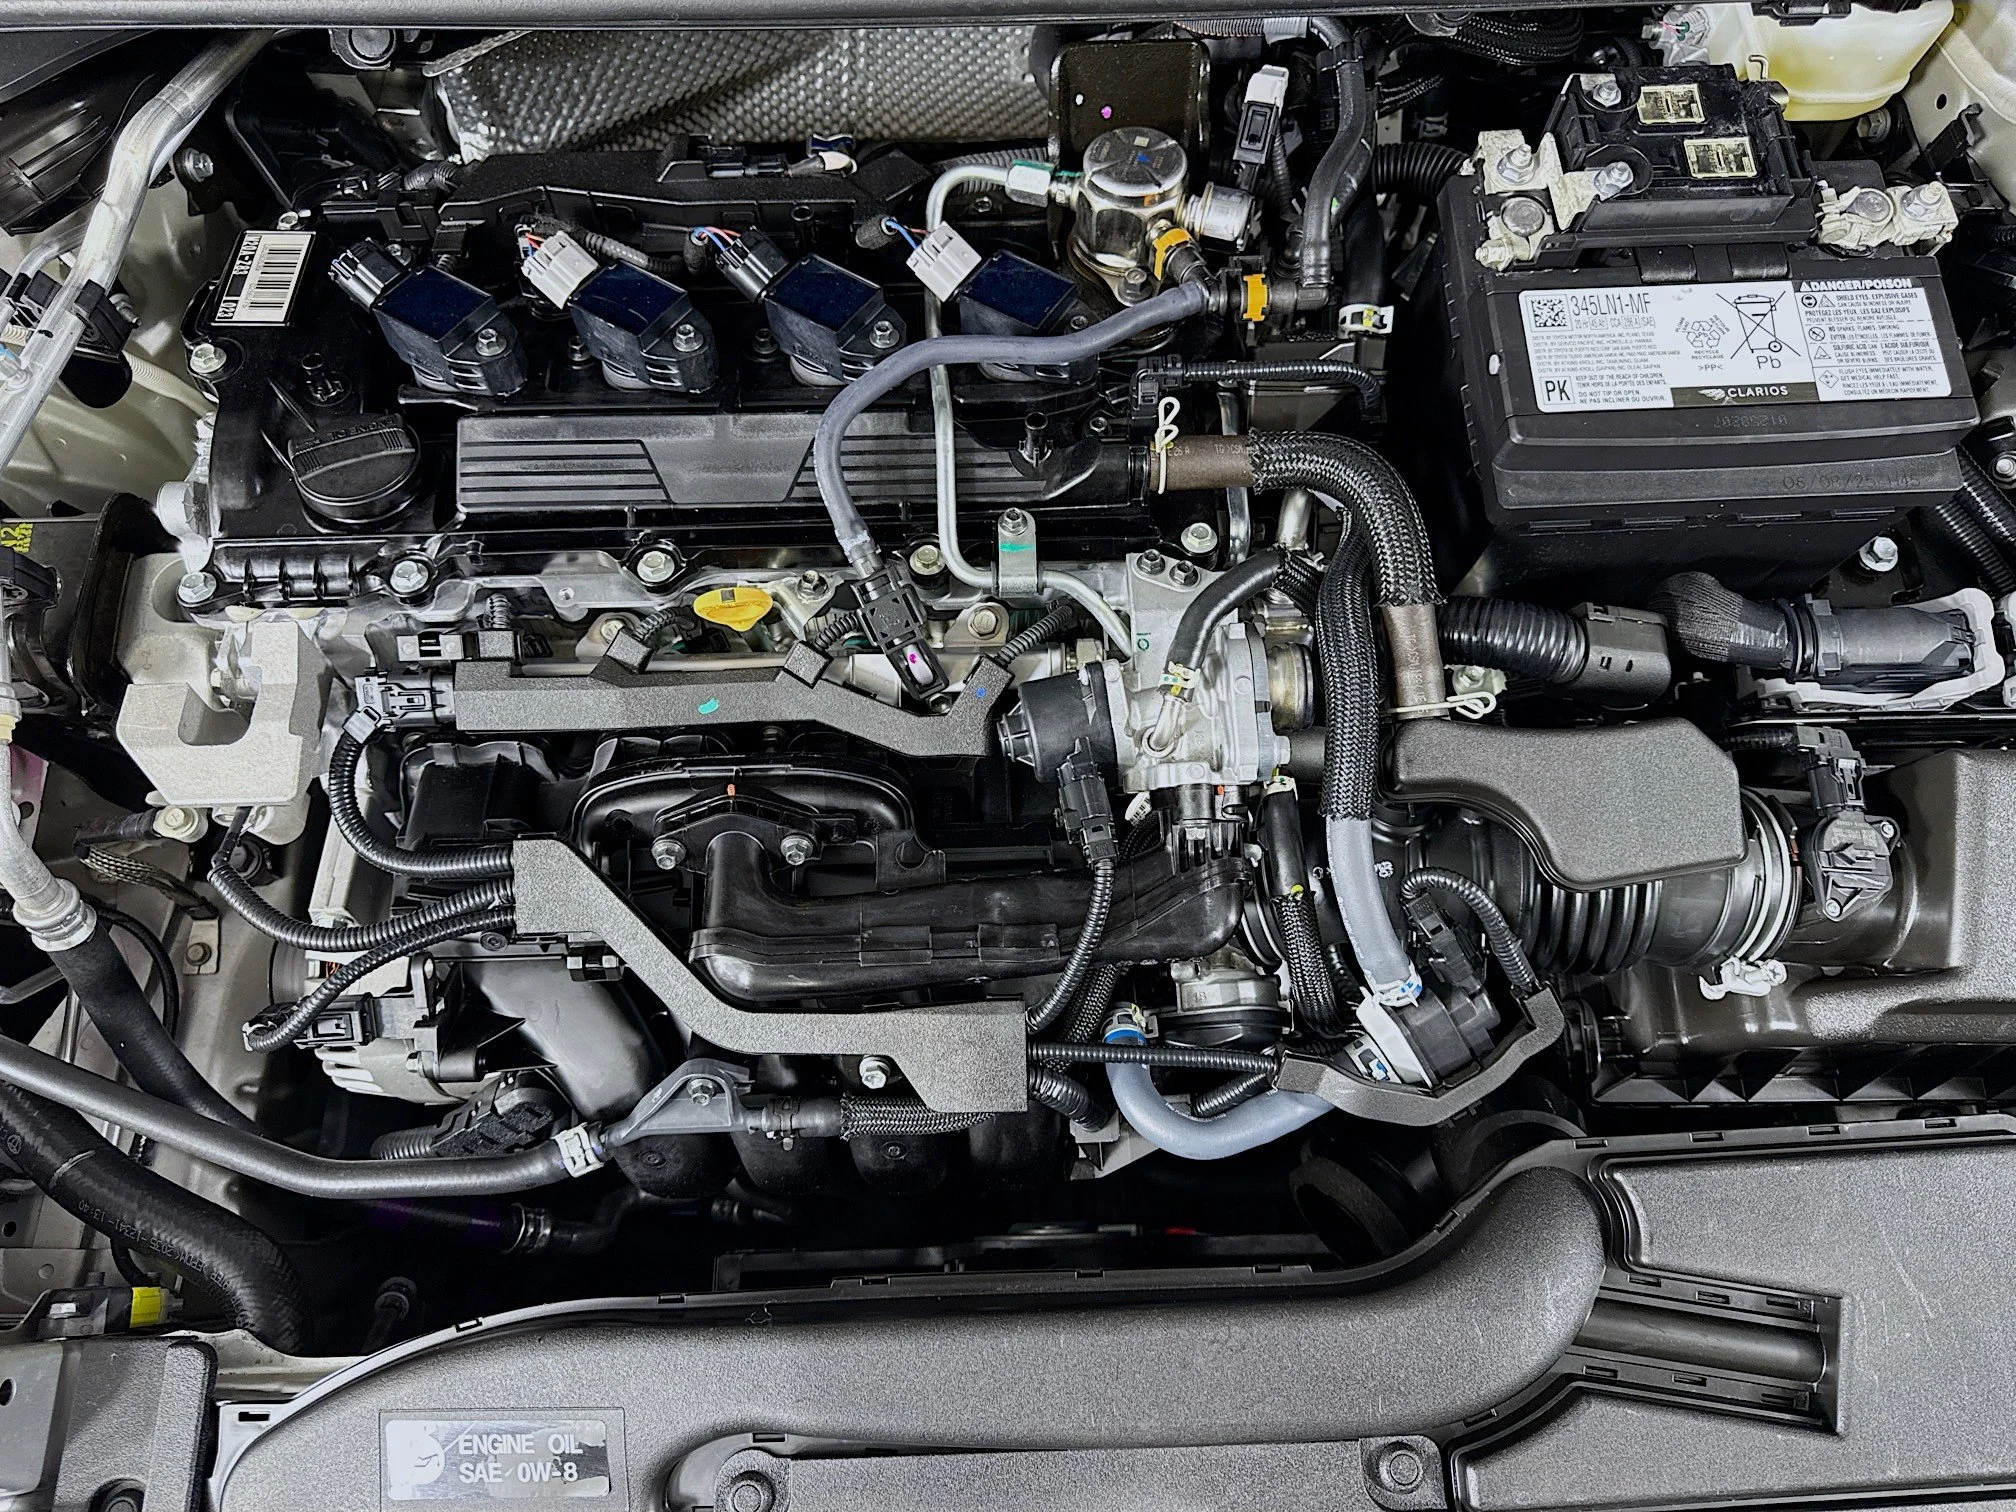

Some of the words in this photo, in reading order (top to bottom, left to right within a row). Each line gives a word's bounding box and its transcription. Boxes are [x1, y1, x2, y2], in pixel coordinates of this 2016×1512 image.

[1810, 278, 1912, 291] DANGER/POISON
[1570, 292, 1652, 316] 345LN1-MF
[1756, 355, 1782, 370] Pb
[1544, 380, 1570, 401] PK
[1728, 386, 1788, 398] CLARIOS
[458, 1434, 535, 1454] ENGINE
[548, 1434, 584, 1454] OIL
[459, 1462, 502, 1484] SAE
[518, 1462, 578, 1482] 0W-8
